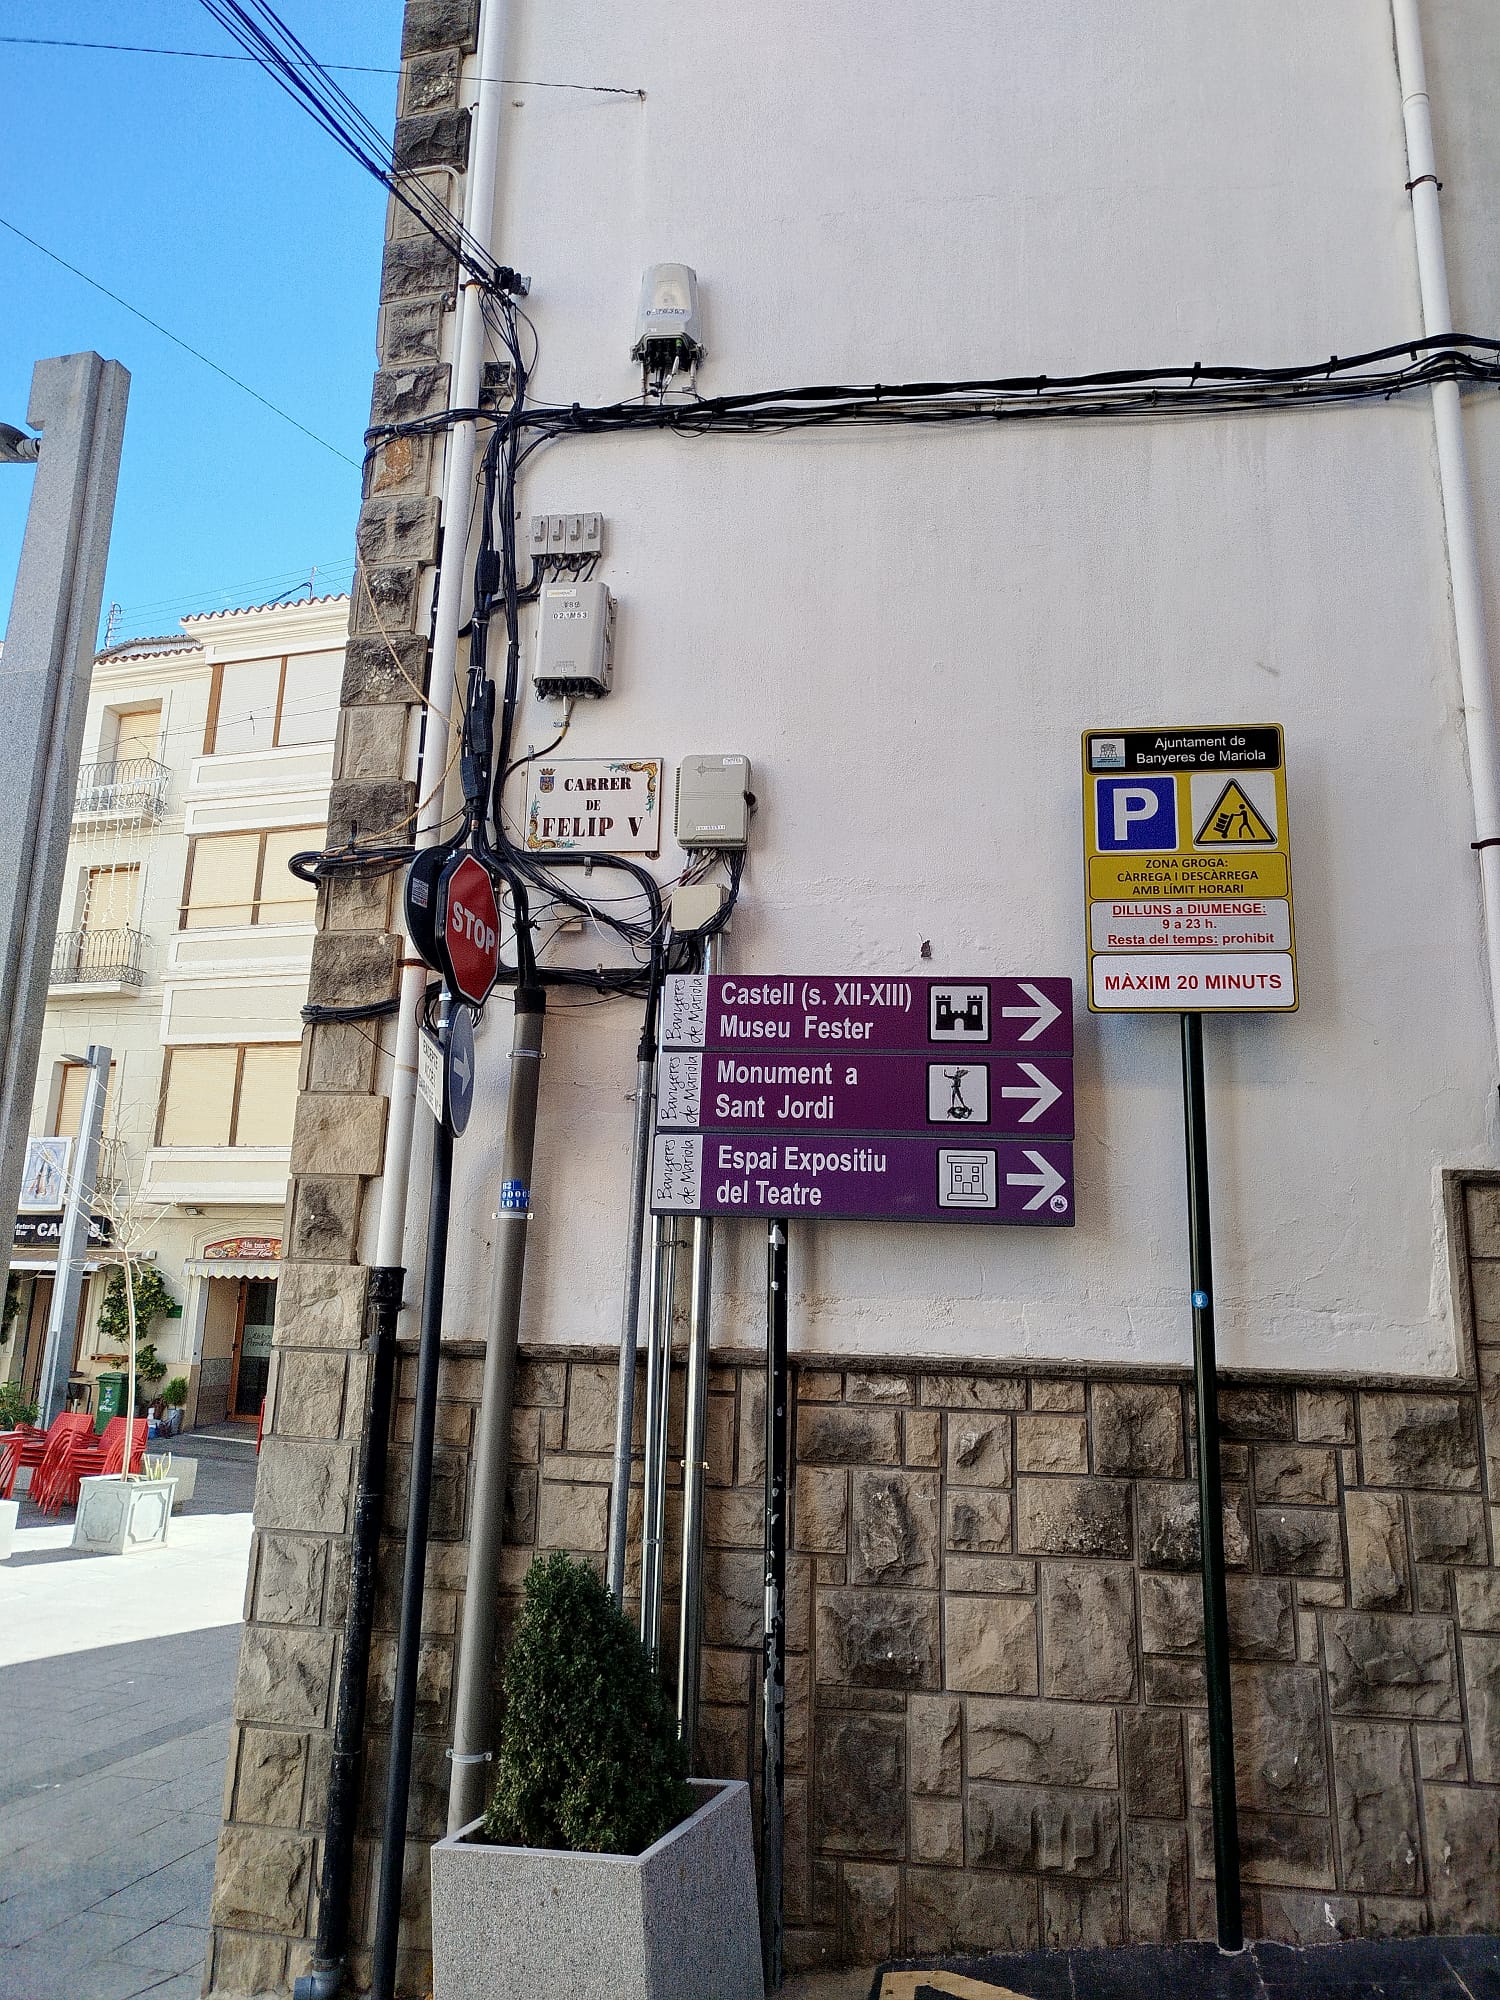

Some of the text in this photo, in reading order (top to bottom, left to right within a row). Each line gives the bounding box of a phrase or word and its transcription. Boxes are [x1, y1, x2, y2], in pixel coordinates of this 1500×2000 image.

[1155, 735, 1246, 751] Ajuntament de
[1136, 750, 1266, 766] Banyeres de Mariola
[564, 777, 632, 792] CARRER
[586, 799, 601, 811] DE
[1112, 787, 1159, 841] P
[542, 816, 644, 838] FELIP V
[1117, 871, 1172, 882] CÀRREGA
[1182, 870, 1259, 881] DESCÀRREGA
[1145, 858, 1229, 869] ZONA GROGA:
[1132, 883, 1244, 895] AMB LÍMIT HORARI
[1112, 903, 1266, 916] DILLUNS a DIUMENGE:
[452, 901, 496, 954] STOP
[1162, 918, 1217, 929] 9 a 23 h.
[1108, 932, 1275, 947] Resta del temps: prohibit
[1105, 972, 1282, 991] MÀXIM 20 MINUTS
[666, 978, 690, 1041] Banyeres
[720, 981, 912, 1012] Castell (s. XII-XIII)
[684, 977, 702, 1043] de Mariola
[719, 1014, 874, 1040] Museu Fester
[717, 1059, 858, 1085] Monument a
[660, 1056, 685, 1120] Banyeres
[679, 1055, 698, 1123] de Mariola
[715, 1094, 834, 1120] Sant Jordi
[656, 1139, 681, 1200] Banyeres
[677, 1139, 695, 1204] de Mariola
[718, 1144, 887, 1177] Espai Expositiu
[716, 1179, 822, 1206] del Teatre
